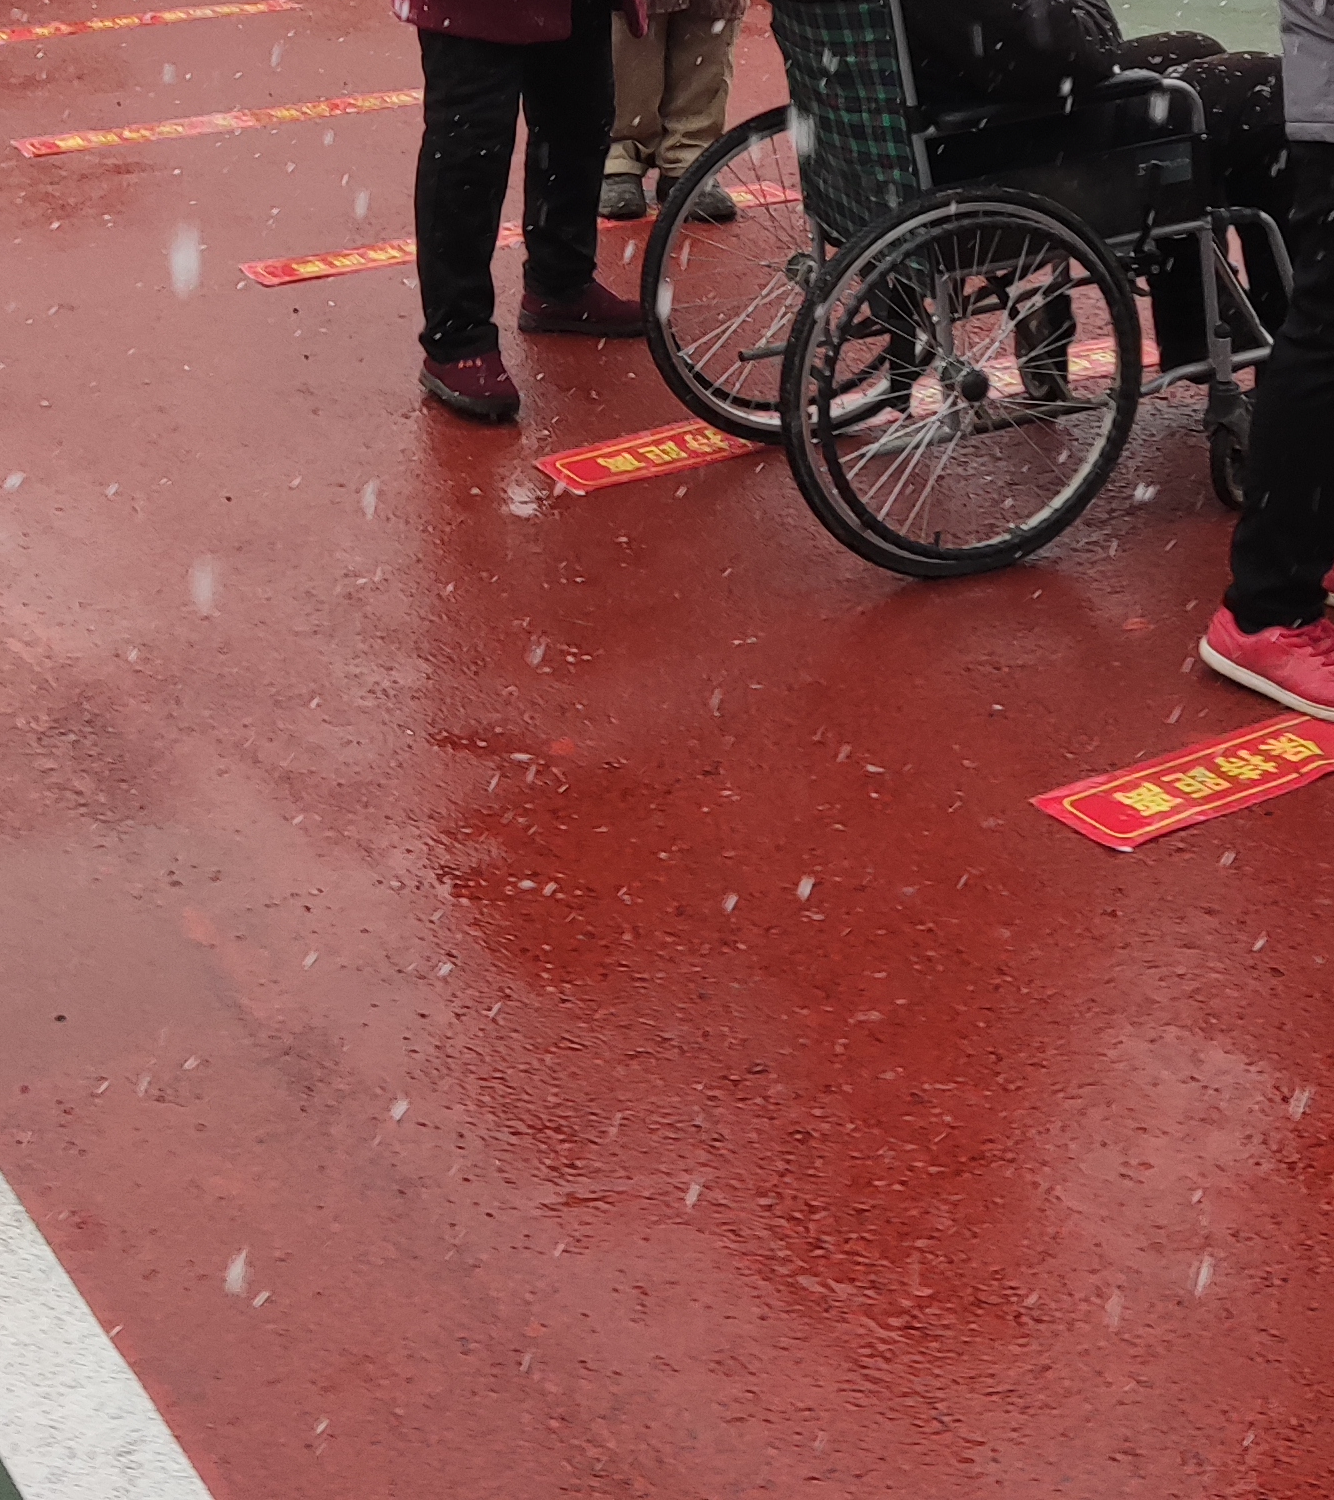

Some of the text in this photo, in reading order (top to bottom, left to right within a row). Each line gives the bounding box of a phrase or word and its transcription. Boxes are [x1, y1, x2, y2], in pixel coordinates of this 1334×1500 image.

[596, 428, 753, 473] 持距离
[1113, 732, 1324, 817] 保持距离
